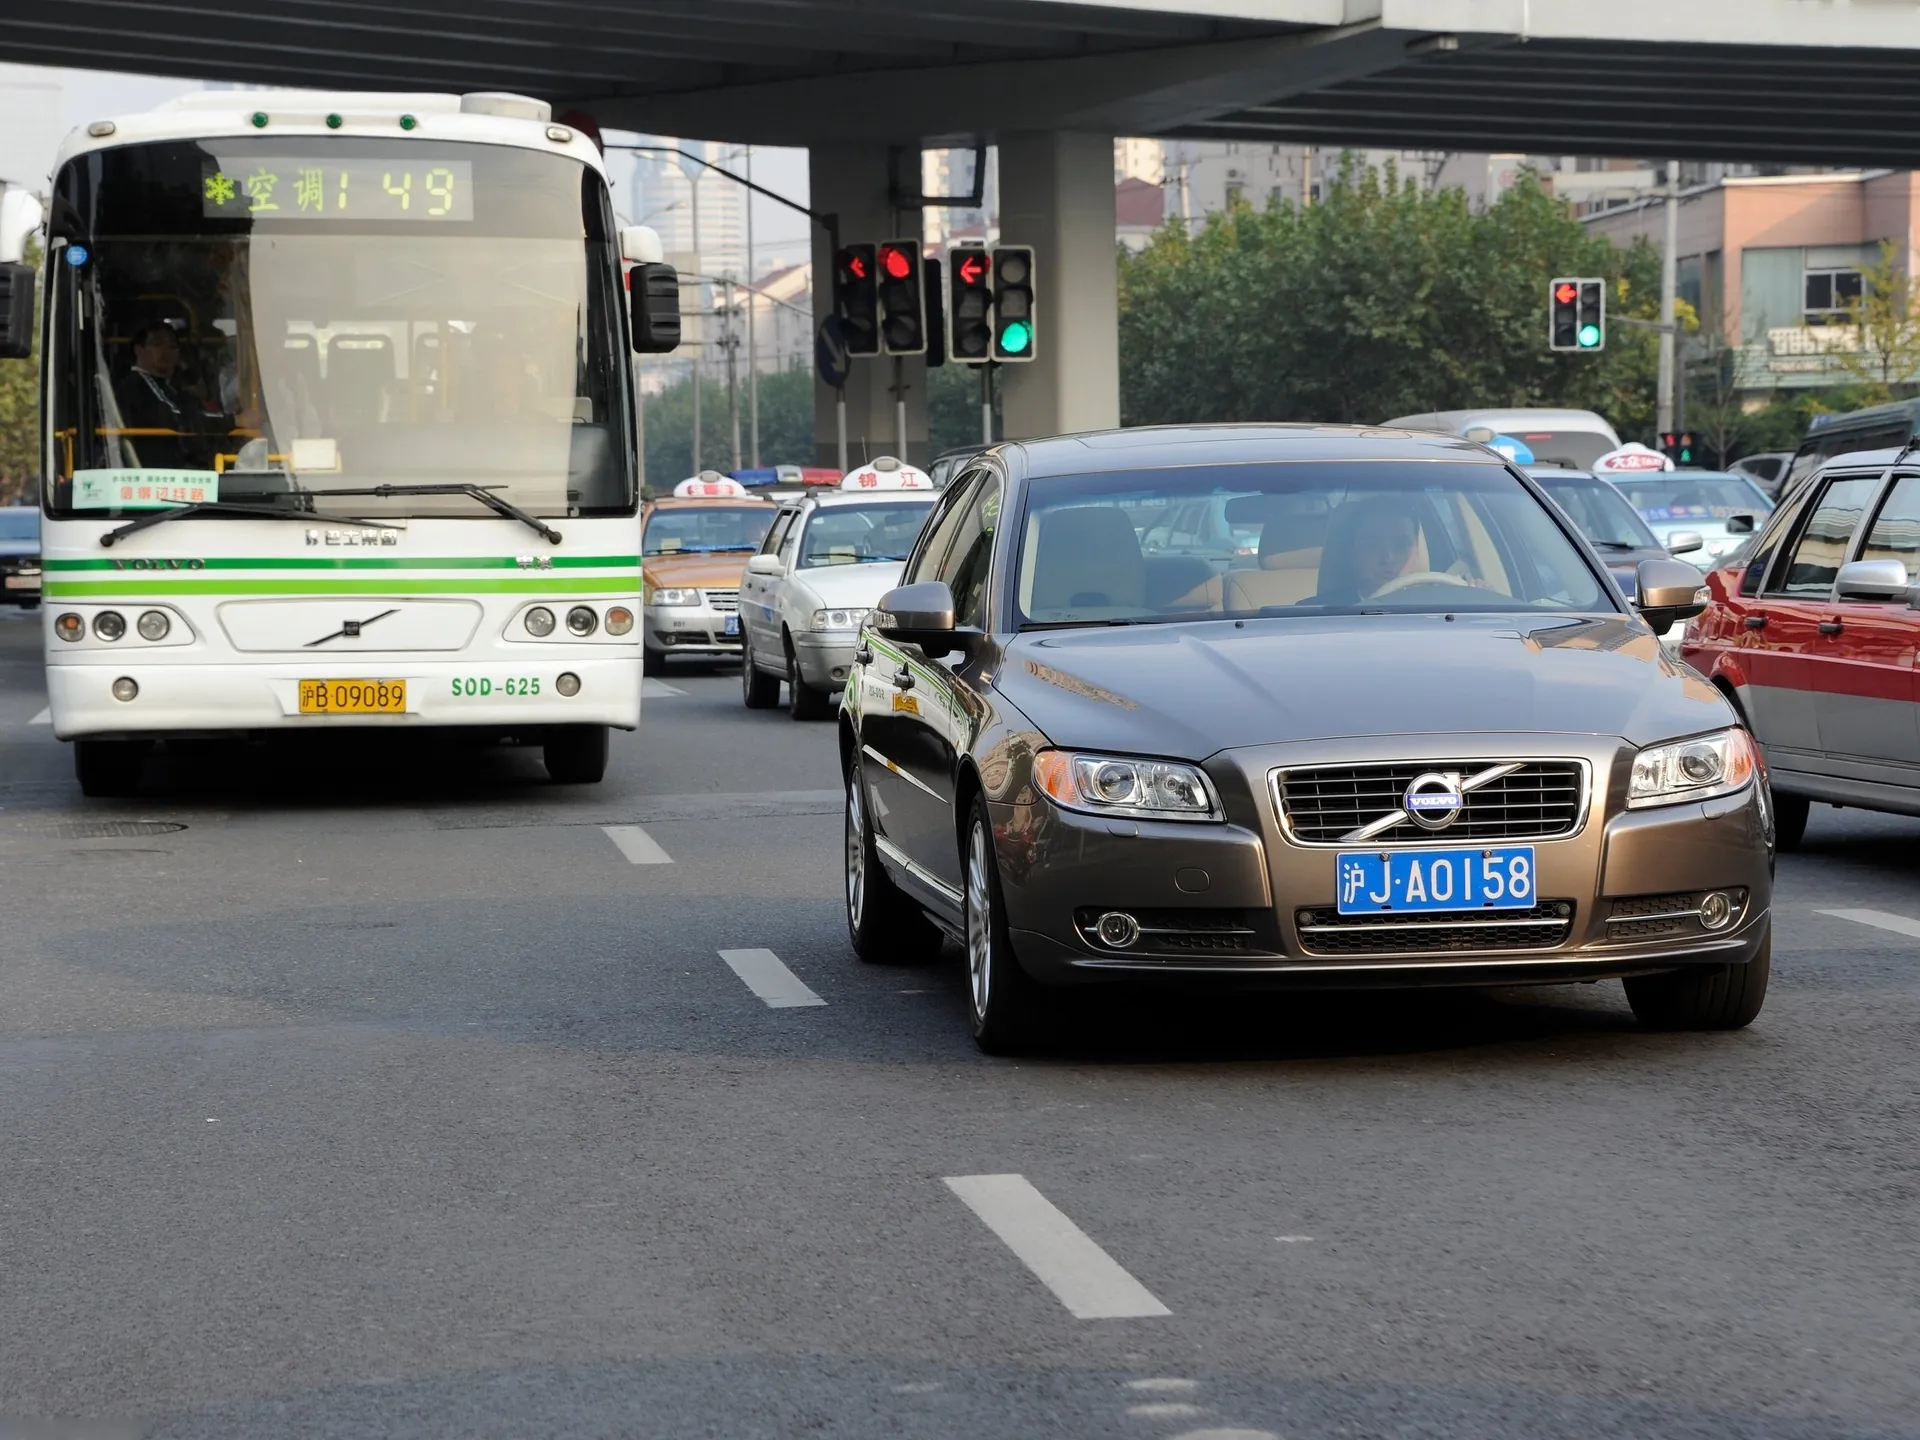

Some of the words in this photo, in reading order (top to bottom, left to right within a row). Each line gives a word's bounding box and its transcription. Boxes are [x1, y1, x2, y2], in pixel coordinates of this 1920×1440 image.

[859, 472, 918, 488] 锦江
[111, 557, 205, 571] VOLVO
[452, 677, 541, 696] SOD-625
[1410, 796, 1457, 806] VOLVO
